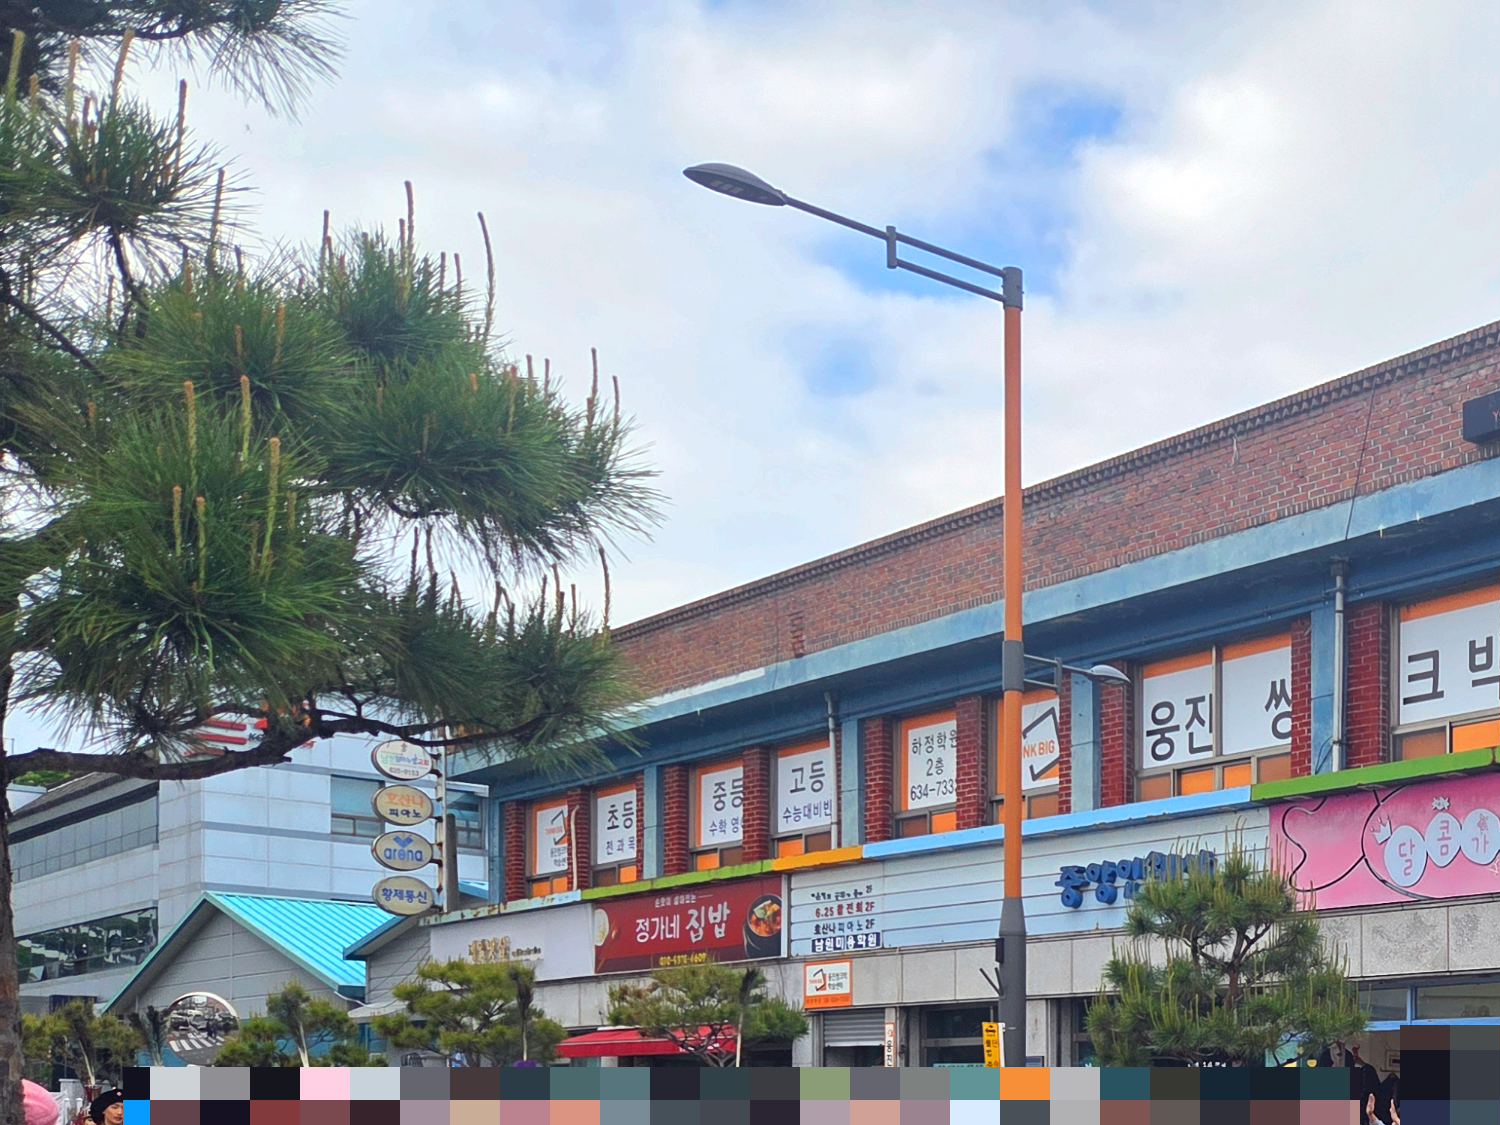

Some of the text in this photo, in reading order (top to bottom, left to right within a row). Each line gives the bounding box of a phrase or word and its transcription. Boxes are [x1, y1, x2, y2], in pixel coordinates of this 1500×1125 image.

[1146, 692, 1213, 762] 웅진
[1038, 740, 1055, 756] BIG
[926, 758, 945, 777] 2층
[789, 760, 826, 794] 고등
[712, 777, 743, 811] 중등
[388, 808, 423, 818] 피아노
[606, 800, 635, 831] 초등
[709, 818, 727, 835] 수학
[383, 847, 423, 862] arena
[381, 887, 428, 905] 황제통신
[815, 906, 835, 918] 6.25
[865, 901, 876, 912] 2F
[636, 901, 731, 943] 정가네 집밥
[865, 918, 876, 930] 2F
[814, 933, 878, 953] 남원미용학원
